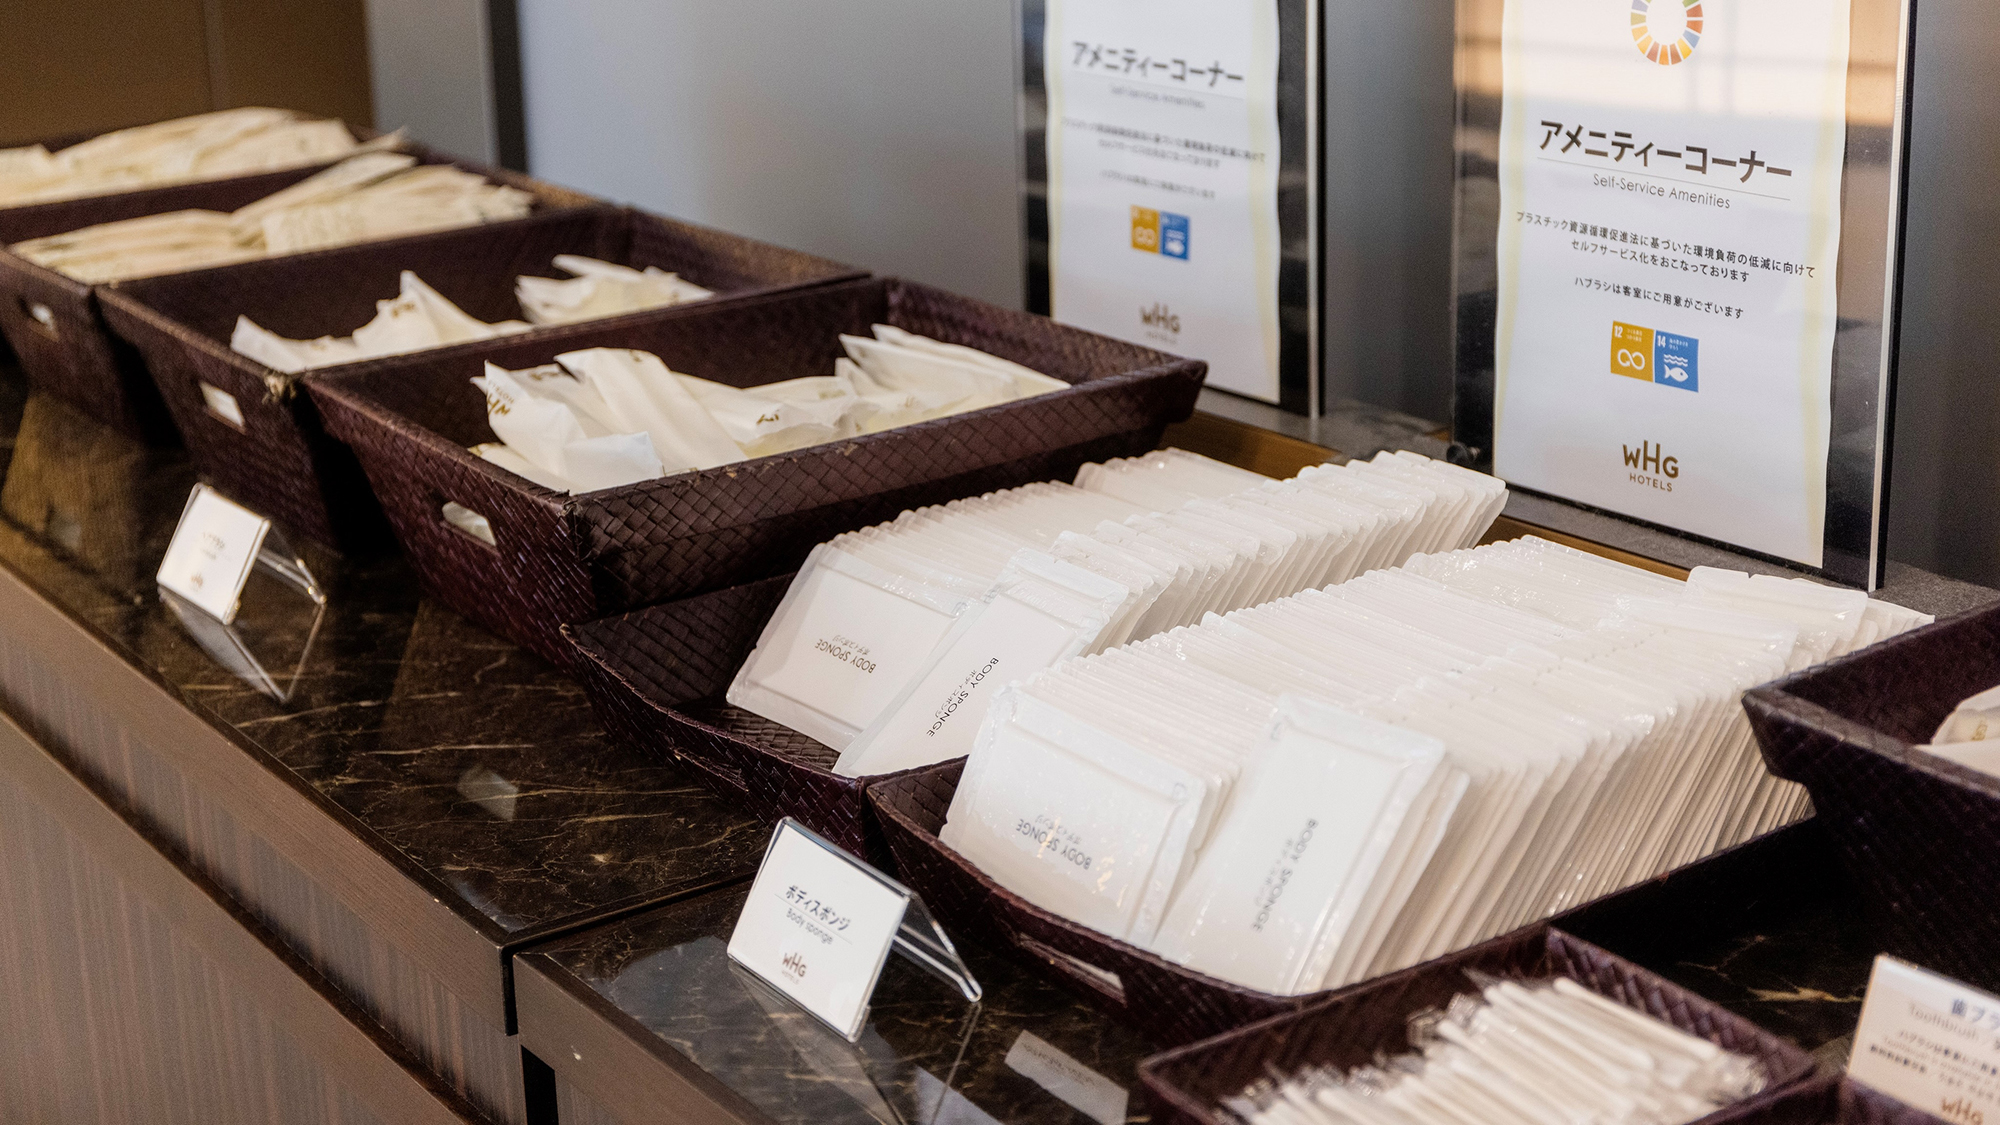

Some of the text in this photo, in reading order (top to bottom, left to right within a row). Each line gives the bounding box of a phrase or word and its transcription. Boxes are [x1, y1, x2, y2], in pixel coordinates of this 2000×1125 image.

[1073, 41, 1244, 87] アメニティーコーナー
[1539, 120, 1792, 183] アメニティーコーナー
[1593, 173, 1731, 209] Self-Service Amenities
[1516, 211, 1815, 278] プラスチック資源循環促進法に基づいた環境負荷の低減に向けて
[1571, 238, 1750, 282] セルフサービス化をおこなっております
[1575, 277, 1744, 319] ハブラシは客室にご用意がございます
[1614, 325, 1623, 339] 12
[1657, 335, 1666, 348] 14
[1629, 472, 1673, 492] HOTELS
[815, 638, 877, 673] BODY SPONGE
[926, 657, 999, 737] BODY SPONGE
[1016, 818, 1092, 870] BODY SPONGE
[1250, 818, 1319, 933] BODY SPONGE
[786, 908, 834, 945] Body sponge
